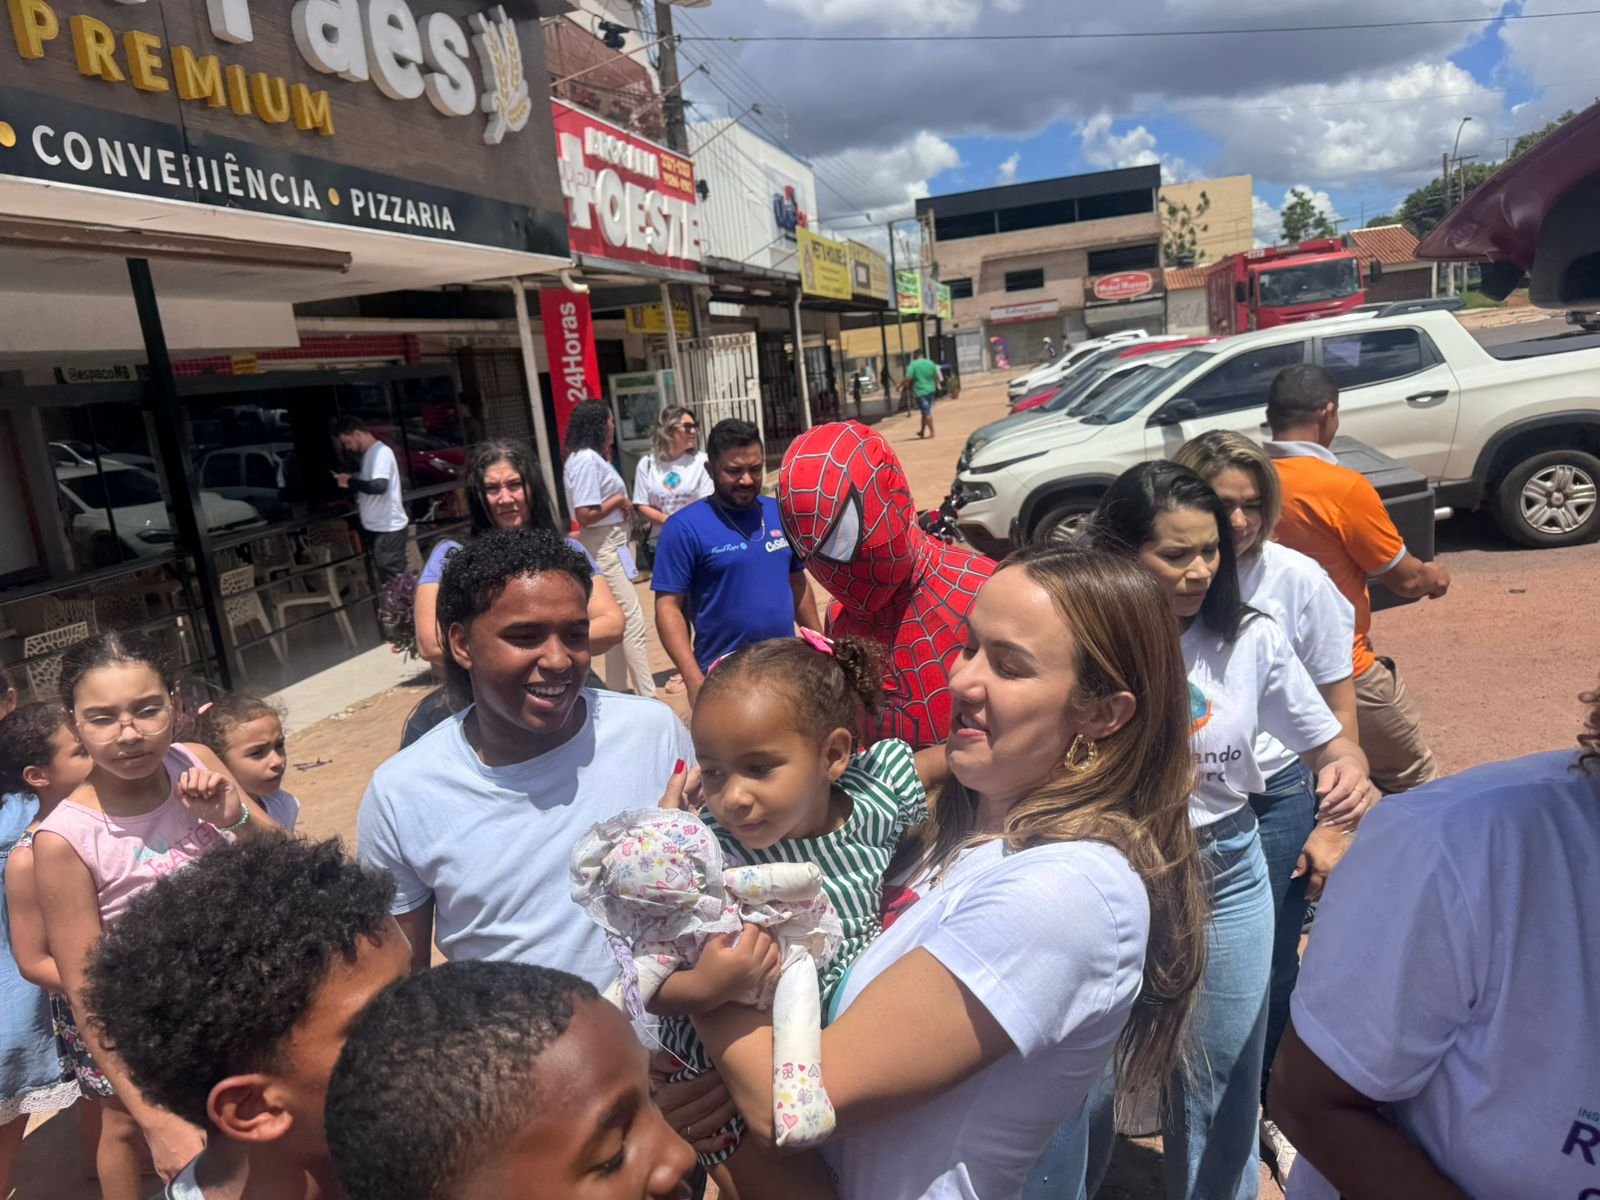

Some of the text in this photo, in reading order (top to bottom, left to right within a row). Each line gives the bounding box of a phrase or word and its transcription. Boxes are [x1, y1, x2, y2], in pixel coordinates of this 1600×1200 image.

[8, 0, 335, 136] PREMIUM
[31, 124, 456, 232] CONVENIÊNCIA PIZZARIA
[594, 168, 703, 262] OESTE
[559, 302, 588, 402] 24Horas
